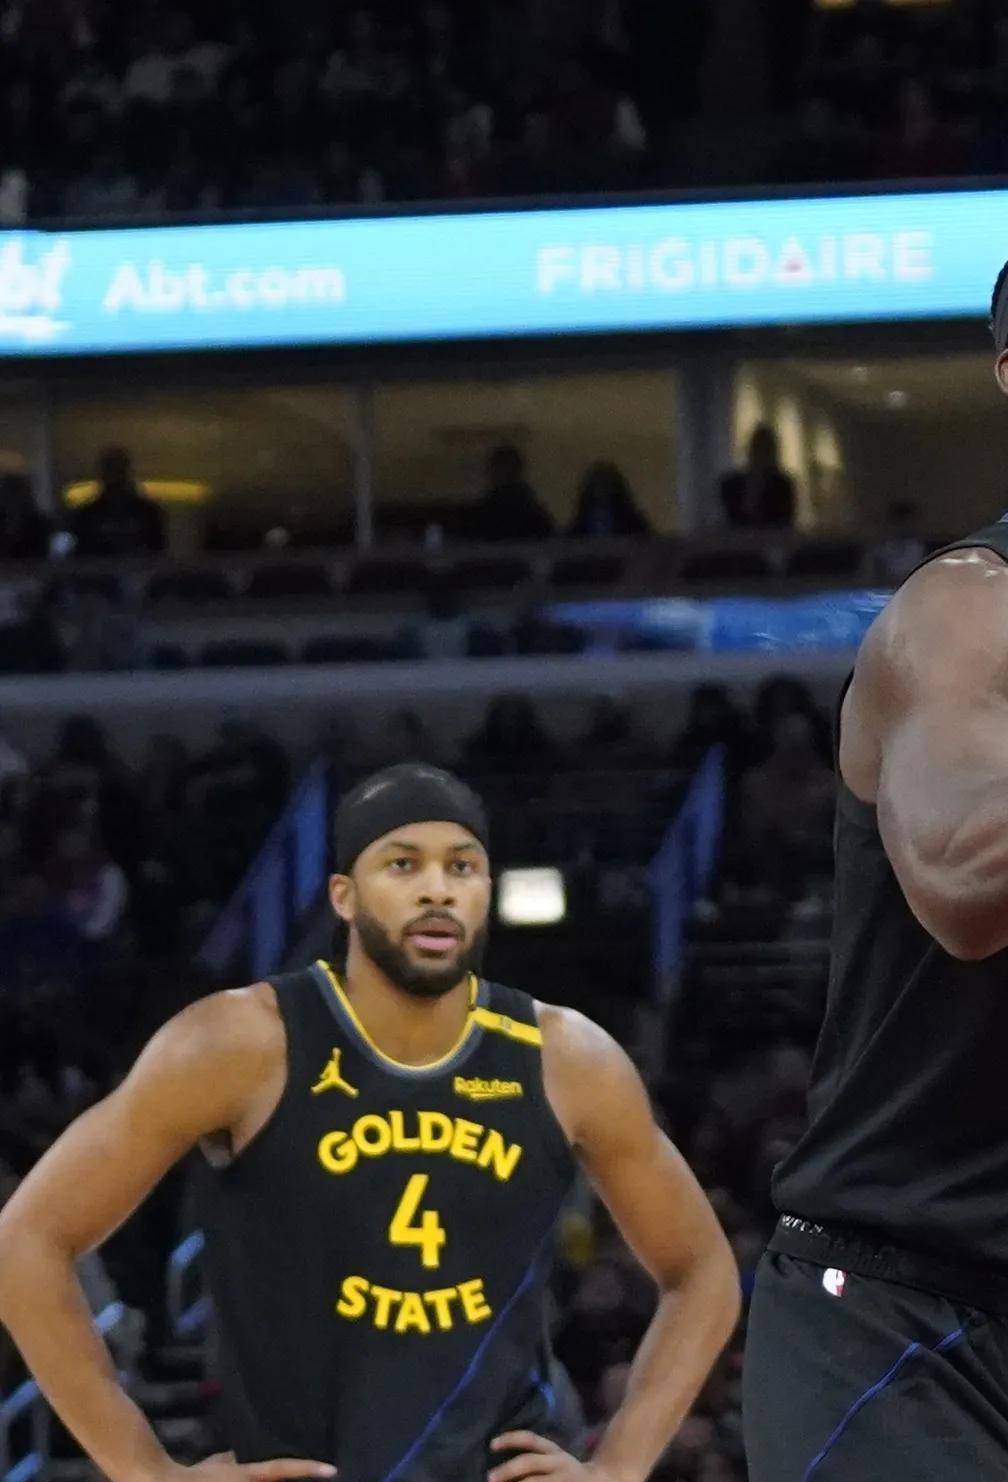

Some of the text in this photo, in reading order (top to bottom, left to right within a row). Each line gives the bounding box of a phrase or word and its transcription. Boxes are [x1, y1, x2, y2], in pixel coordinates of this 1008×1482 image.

[103, 260, 345, 313] Abt.com
[537, 228, 932, 297] FRIGIDAIRE
[318, 1110, 522, 1181] GOLDEN
[389, 1173, 446, 1269] 4
[336, 1276, 492, 1333] STATE
